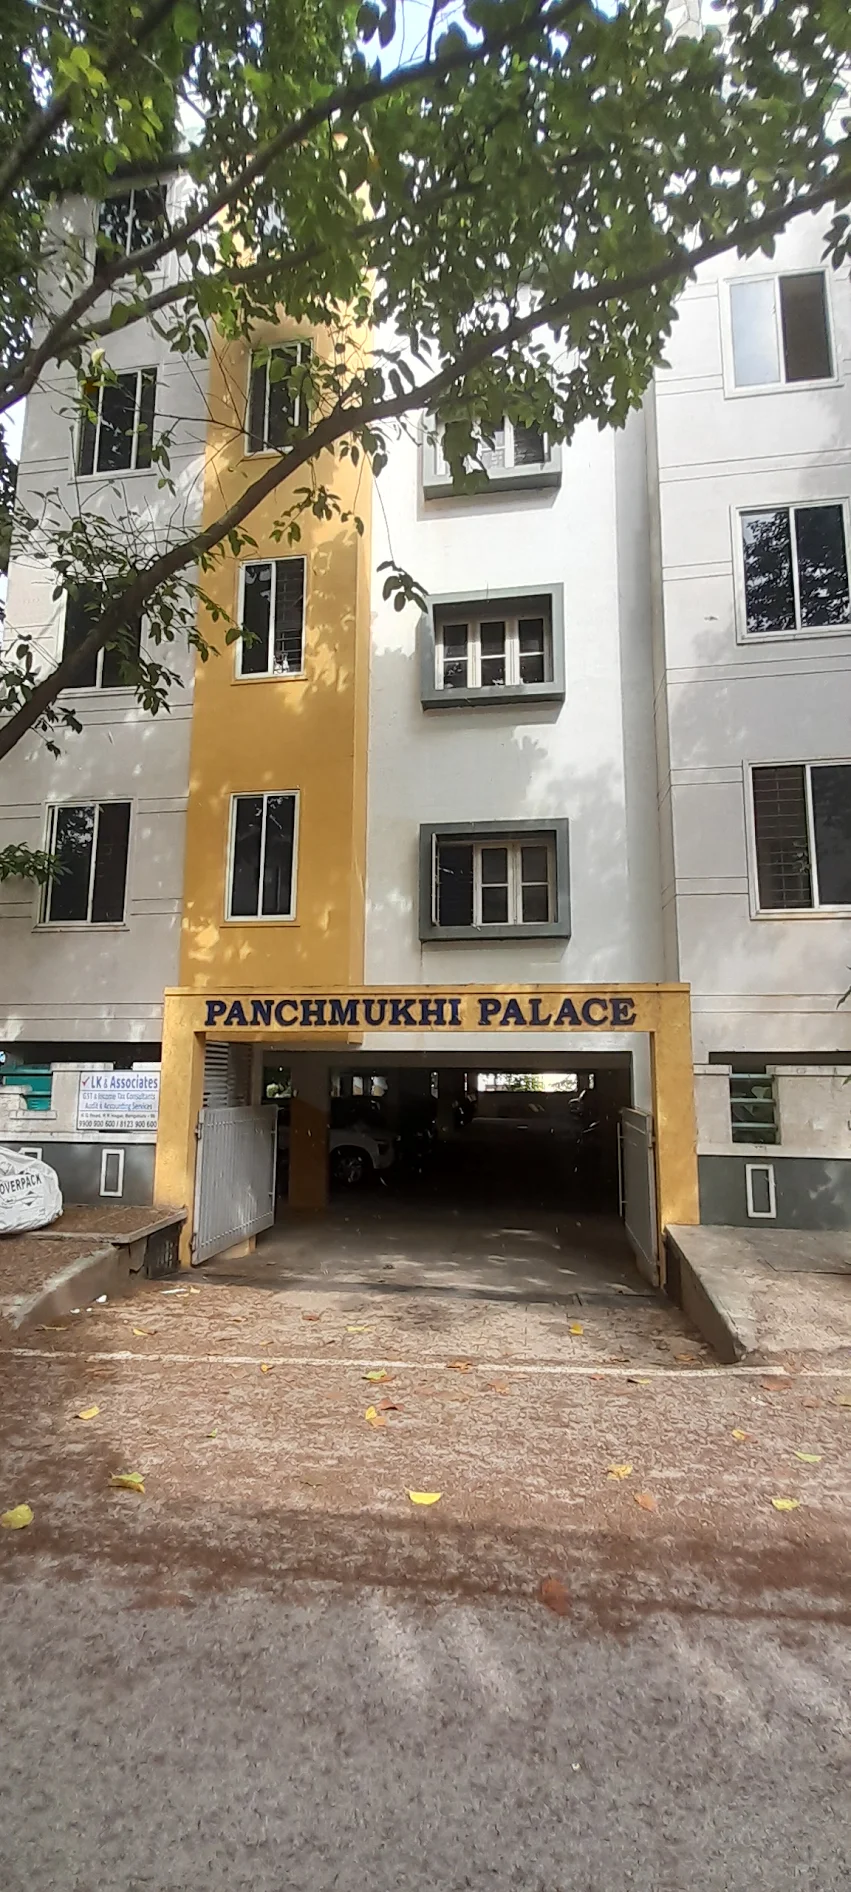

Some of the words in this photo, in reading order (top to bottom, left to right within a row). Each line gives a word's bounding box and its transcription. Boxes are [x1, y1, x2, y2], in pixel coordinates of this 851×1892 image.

[204, 998, 462, 1027] PANCHMUKHI
[478, 997, 637, 1026] PALACE
[91, 1076, 102, 1089] LK
[103, 1078, 108, 1089] &
[110, 1074, 158, 1089] Associates
[85, 1102, 98, 1110] Audit
[104, 1102, 131, 1111] Accounting
[132, 1102, 152, 1110] Services
[0, 1174, 42, 1195] OVERPACK
